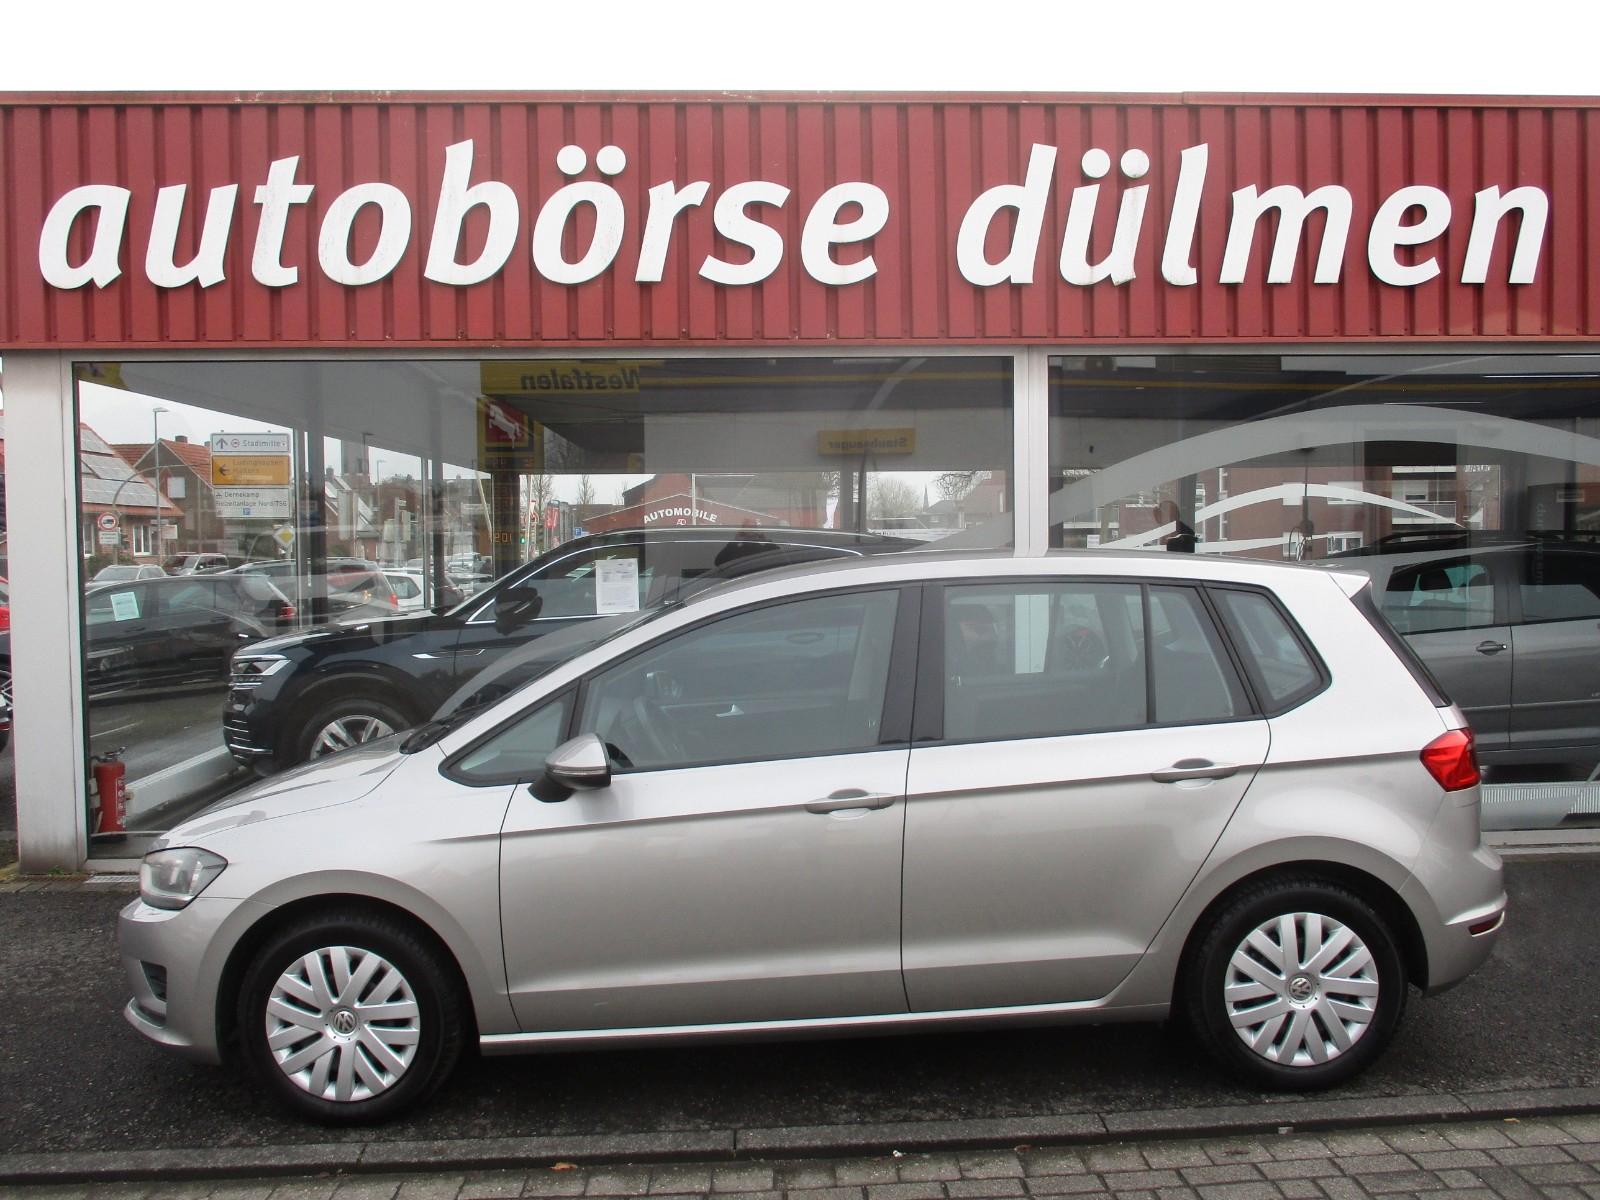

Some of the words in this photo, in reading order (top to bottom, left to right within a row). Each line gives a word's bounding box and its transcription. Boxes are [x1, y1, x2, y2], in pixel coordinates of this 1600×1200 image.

[38, 138, 890, 289] autobörse
[956, 142, 1549, 287] dülmen
[643, 507, 718, 524] AUTOMOBILE
